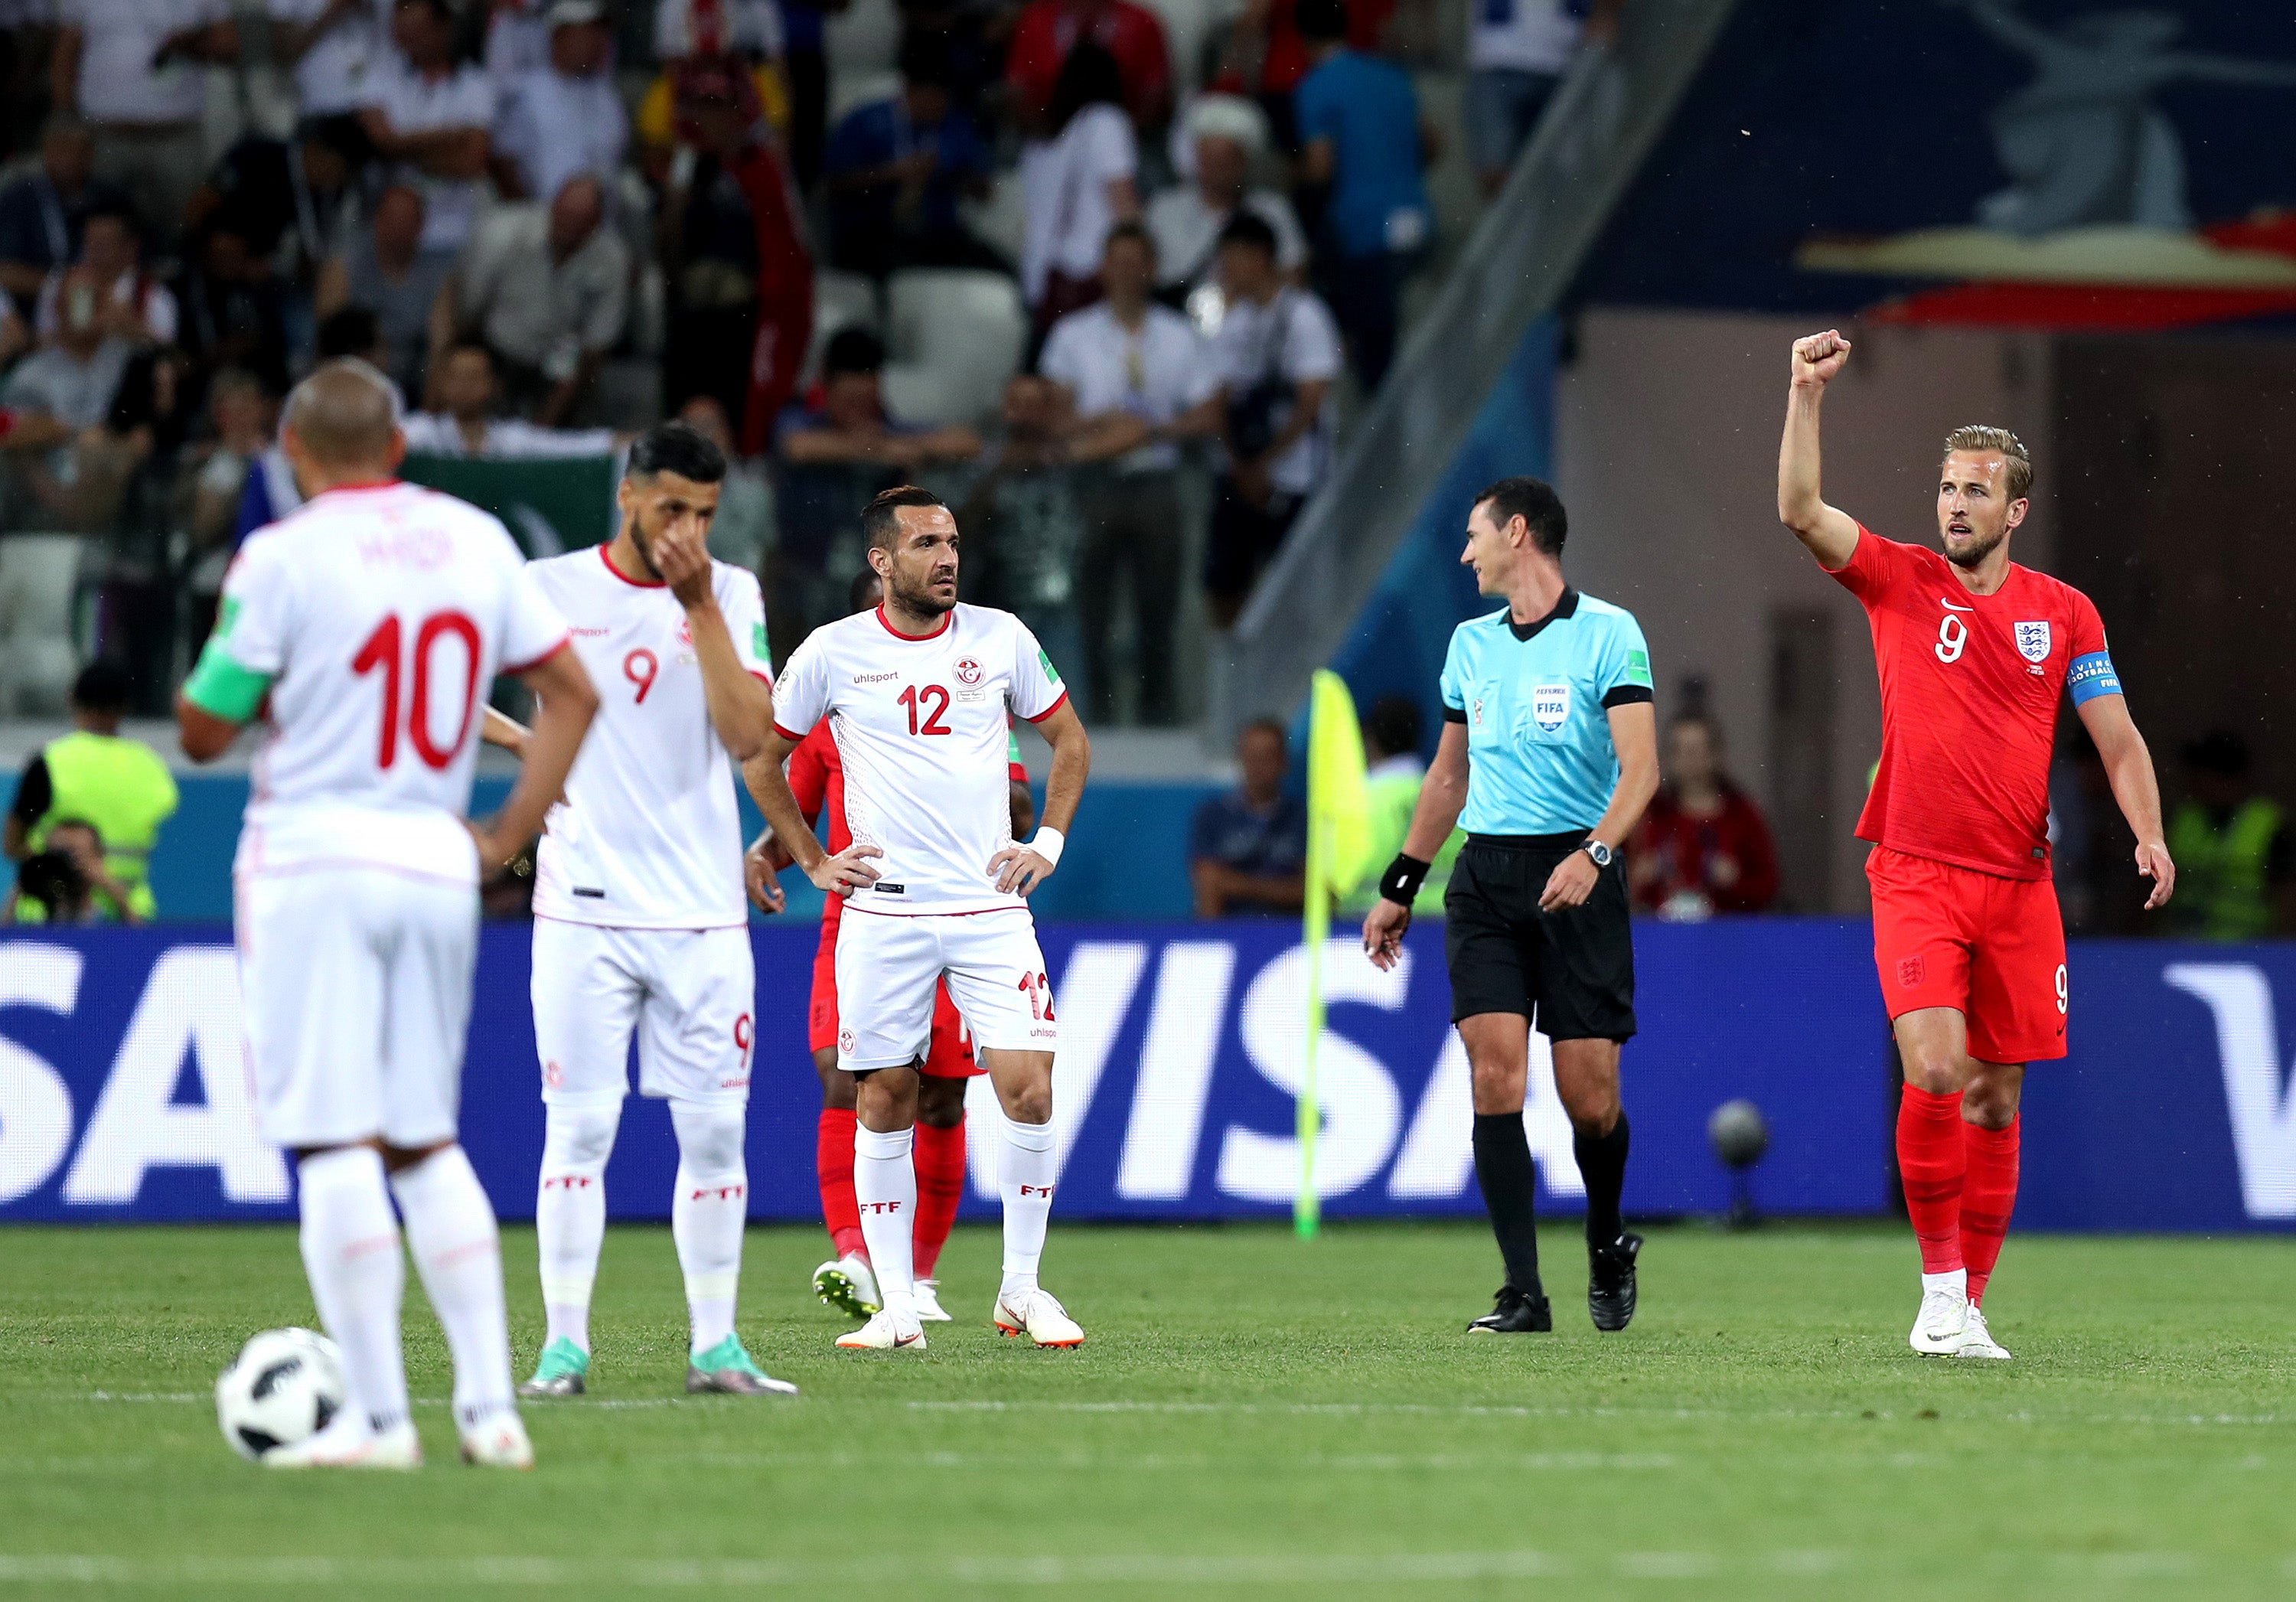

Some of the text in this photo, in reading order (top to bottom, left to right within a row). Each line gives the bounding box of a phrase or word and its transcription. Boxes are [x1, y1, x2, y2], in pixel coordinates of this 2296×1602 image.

[1935, 614, 1968, 664] 9
[352, 609, 482, 772] 10
[624, 648, 659, 705] 9
[853, 671, 899, 684] uhlsport
[2100, 678, 2119, 688] FIFA
[897, 684, 952, 736] 12
[1537, 703, 1564, 713] FIFA
[1018, 971, 1056, 1021] 12
[2055, 963, 2068, 1015] 9
[733, 1011, 755, 1070] 9
[860, 1201, 901, 1215] FTF
